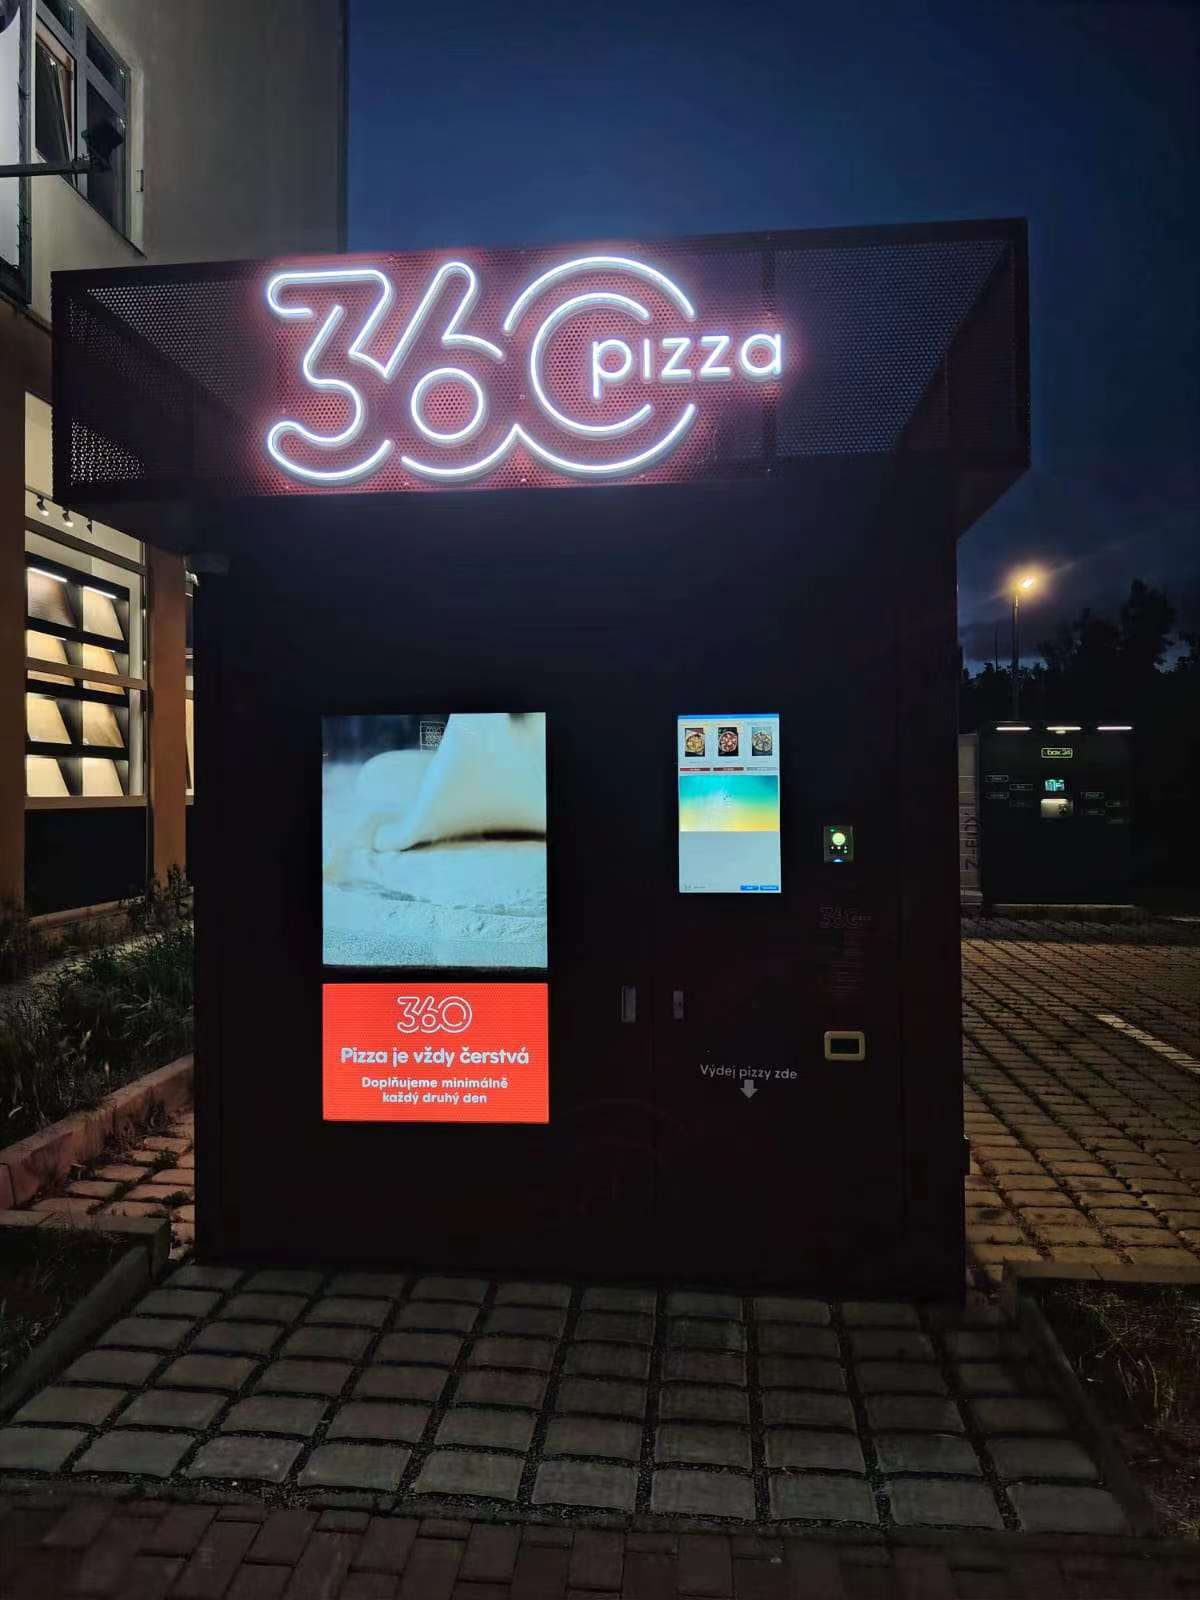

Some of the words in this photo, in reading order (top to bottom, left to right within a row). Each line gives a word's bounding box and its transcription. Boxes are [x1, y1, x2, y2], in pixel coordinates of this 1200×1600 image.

[265, 254, 698, 483] 360
[591, 331, 784, 400] pizza
[396, 995, 473, 1034] 360
[340, 1046, 388, 1064] Pizza
[392, 1046, 409, 1067] je
[413, 1045, 456, 1068] vždy
[459, 1046, 530, 1065] čerstvá
[700, 1063, 736, 1079] Výdej
[739, 1065, 772, 1081] pizzy
[774, 1067, 798, 1079] zde
[361, 1076, 438, 1089] Doplňujeme
[441, 1076, 509, 1089] minimálně
[382, 1091, 419, 1105] každý
[422, 1091, 460, 1105] druhý
[462, 1092, 488, 1104] den
